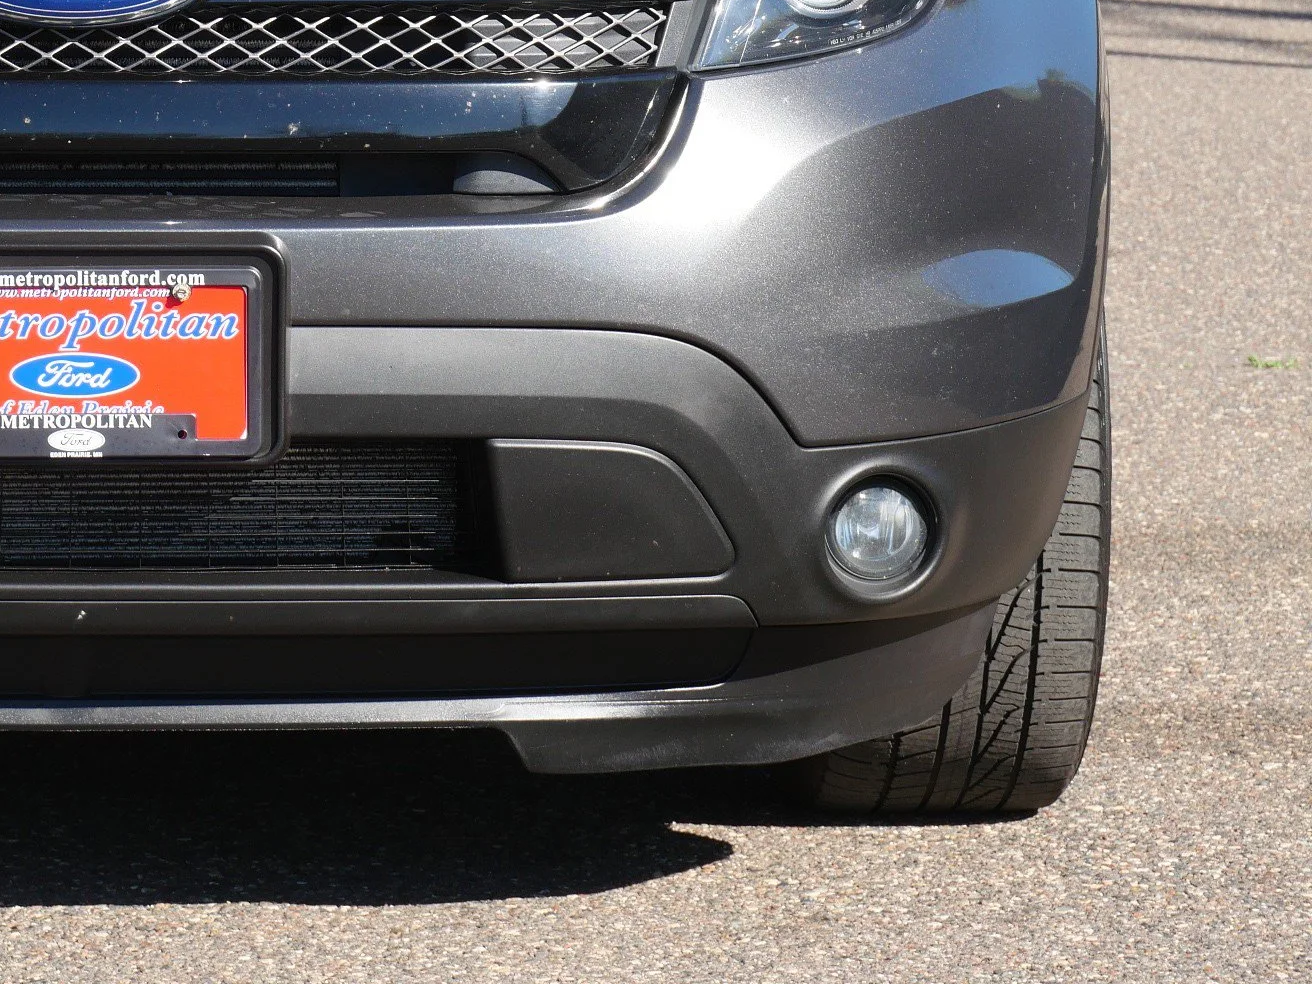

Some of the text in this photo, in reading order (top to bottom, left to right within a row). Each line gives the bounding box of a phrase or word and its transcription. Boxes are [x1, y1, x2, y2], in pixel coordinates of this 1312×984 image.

[36, 357, 111, 389] Ford
[0, 414, 153, 429] METROPOLITAN
[60, 432, 93, 447] Ford
